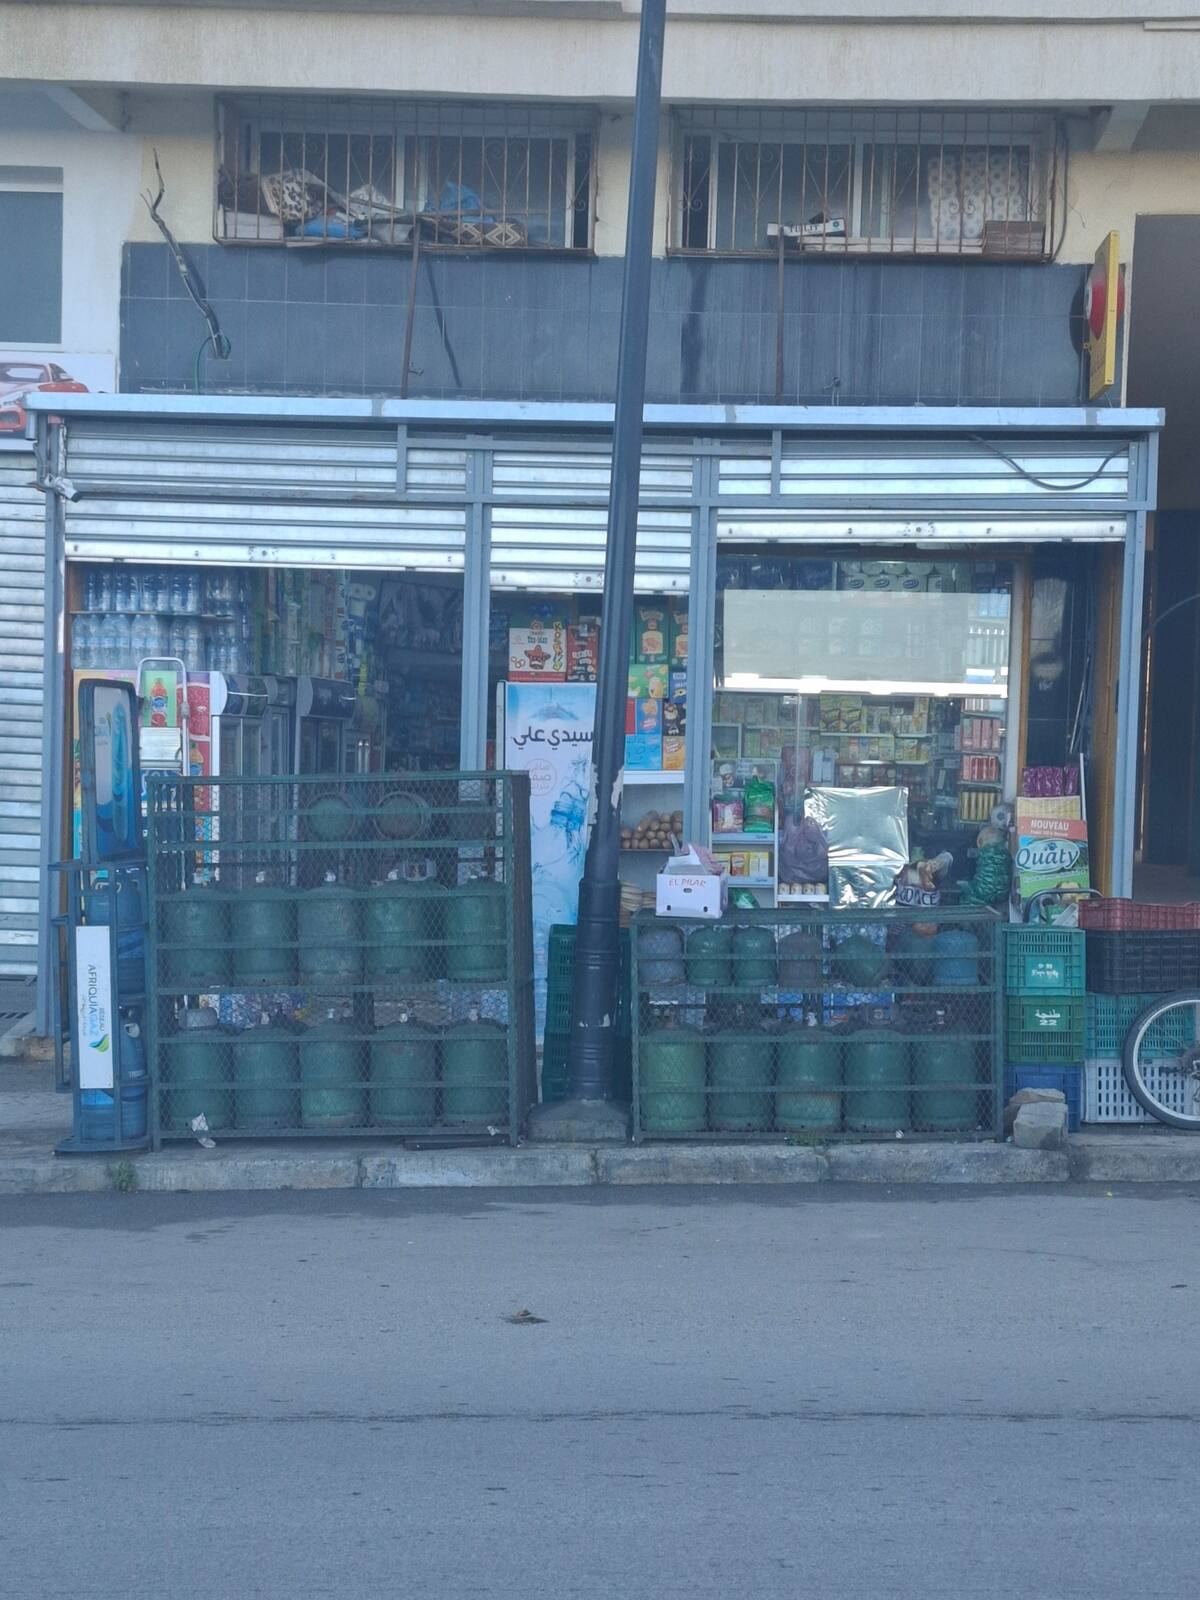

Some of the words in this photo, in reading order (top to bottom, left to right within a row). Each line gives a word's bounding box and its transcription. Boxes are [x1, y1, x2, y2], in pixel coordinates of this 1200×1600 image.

[513, 725, 545, 750] علي
[547, 728, 594, 751] سيدي
[1031, 819, 1070, 831] NOUVEAU
[1016, 848, 1079, 869] Quaty
